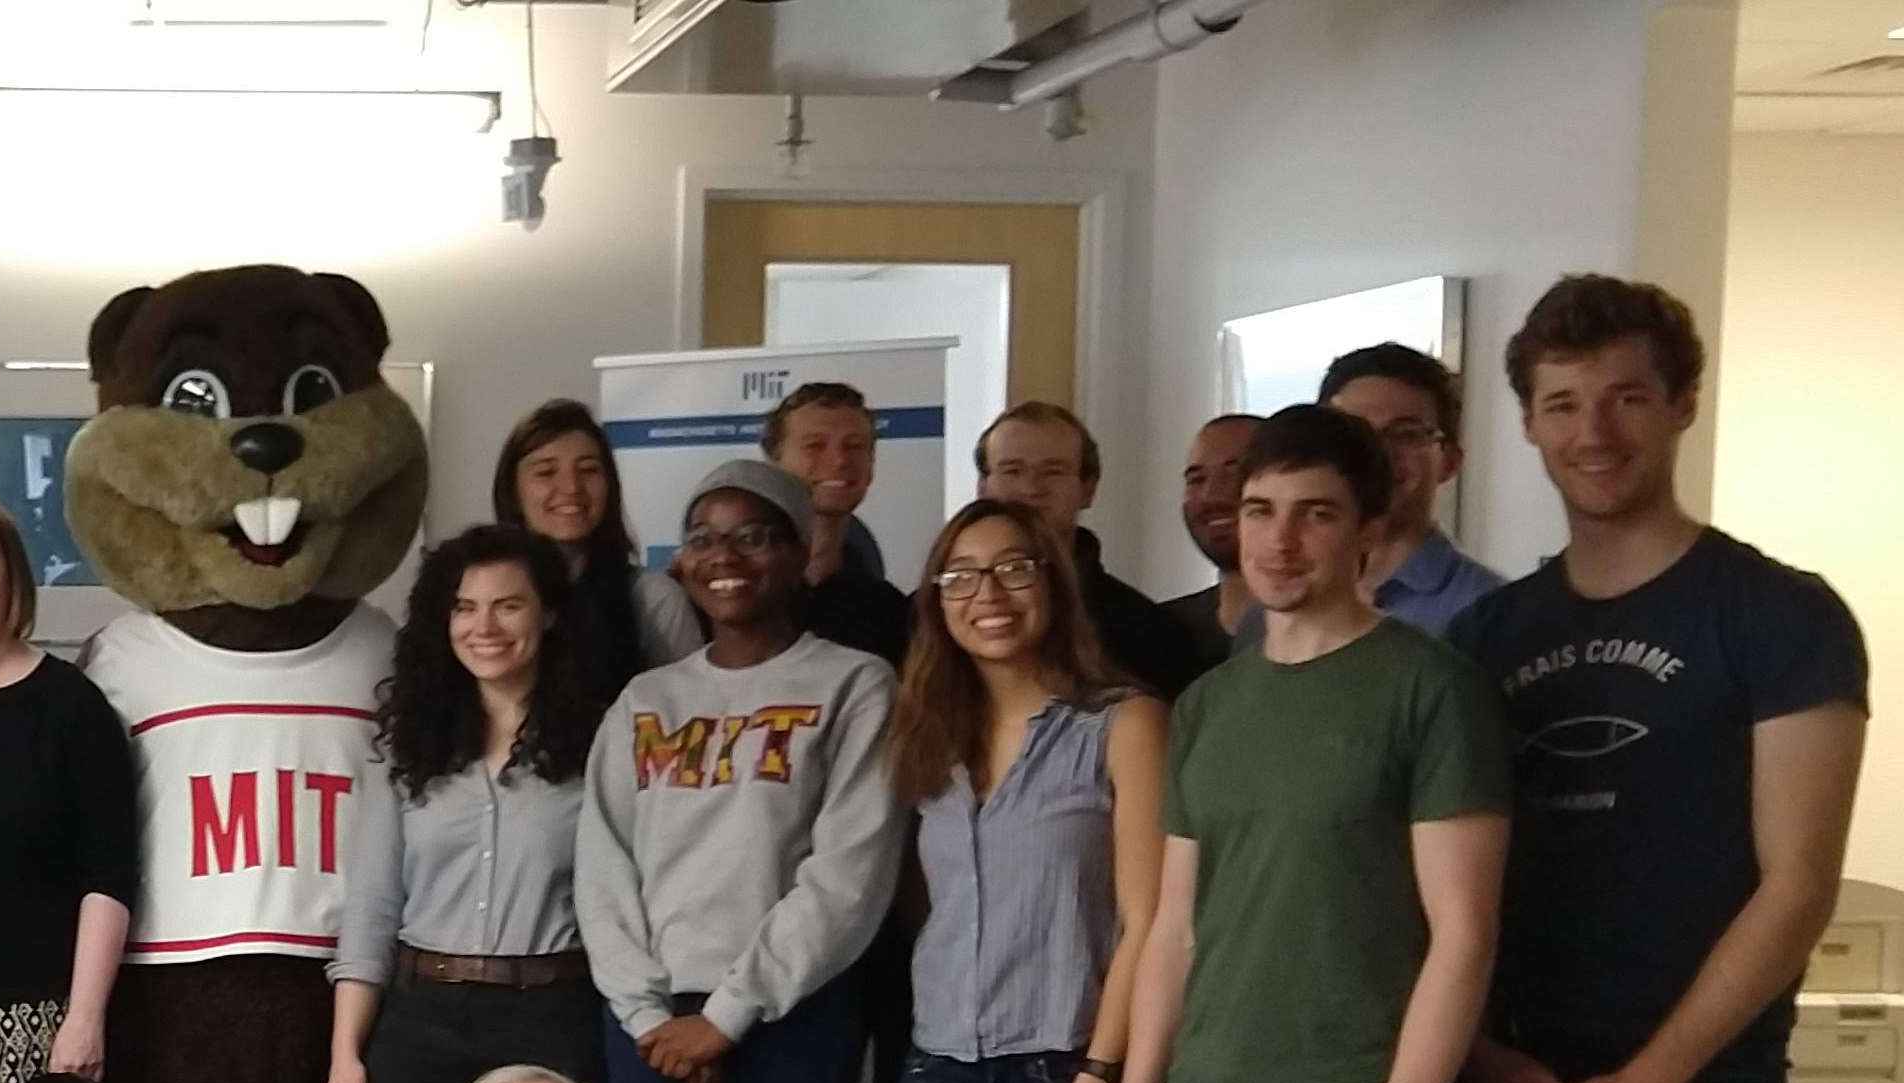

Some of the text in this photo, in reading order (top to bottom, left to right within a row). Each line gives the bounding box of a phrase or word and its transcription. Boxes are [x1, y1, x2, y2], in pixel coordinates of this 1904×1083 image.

[742, 370, 790, 400] MIT
[1585, 638, 1685, 682] COMME
[633, 704, 823, 791] MIT
[189, 768, 354, 878] MIT
